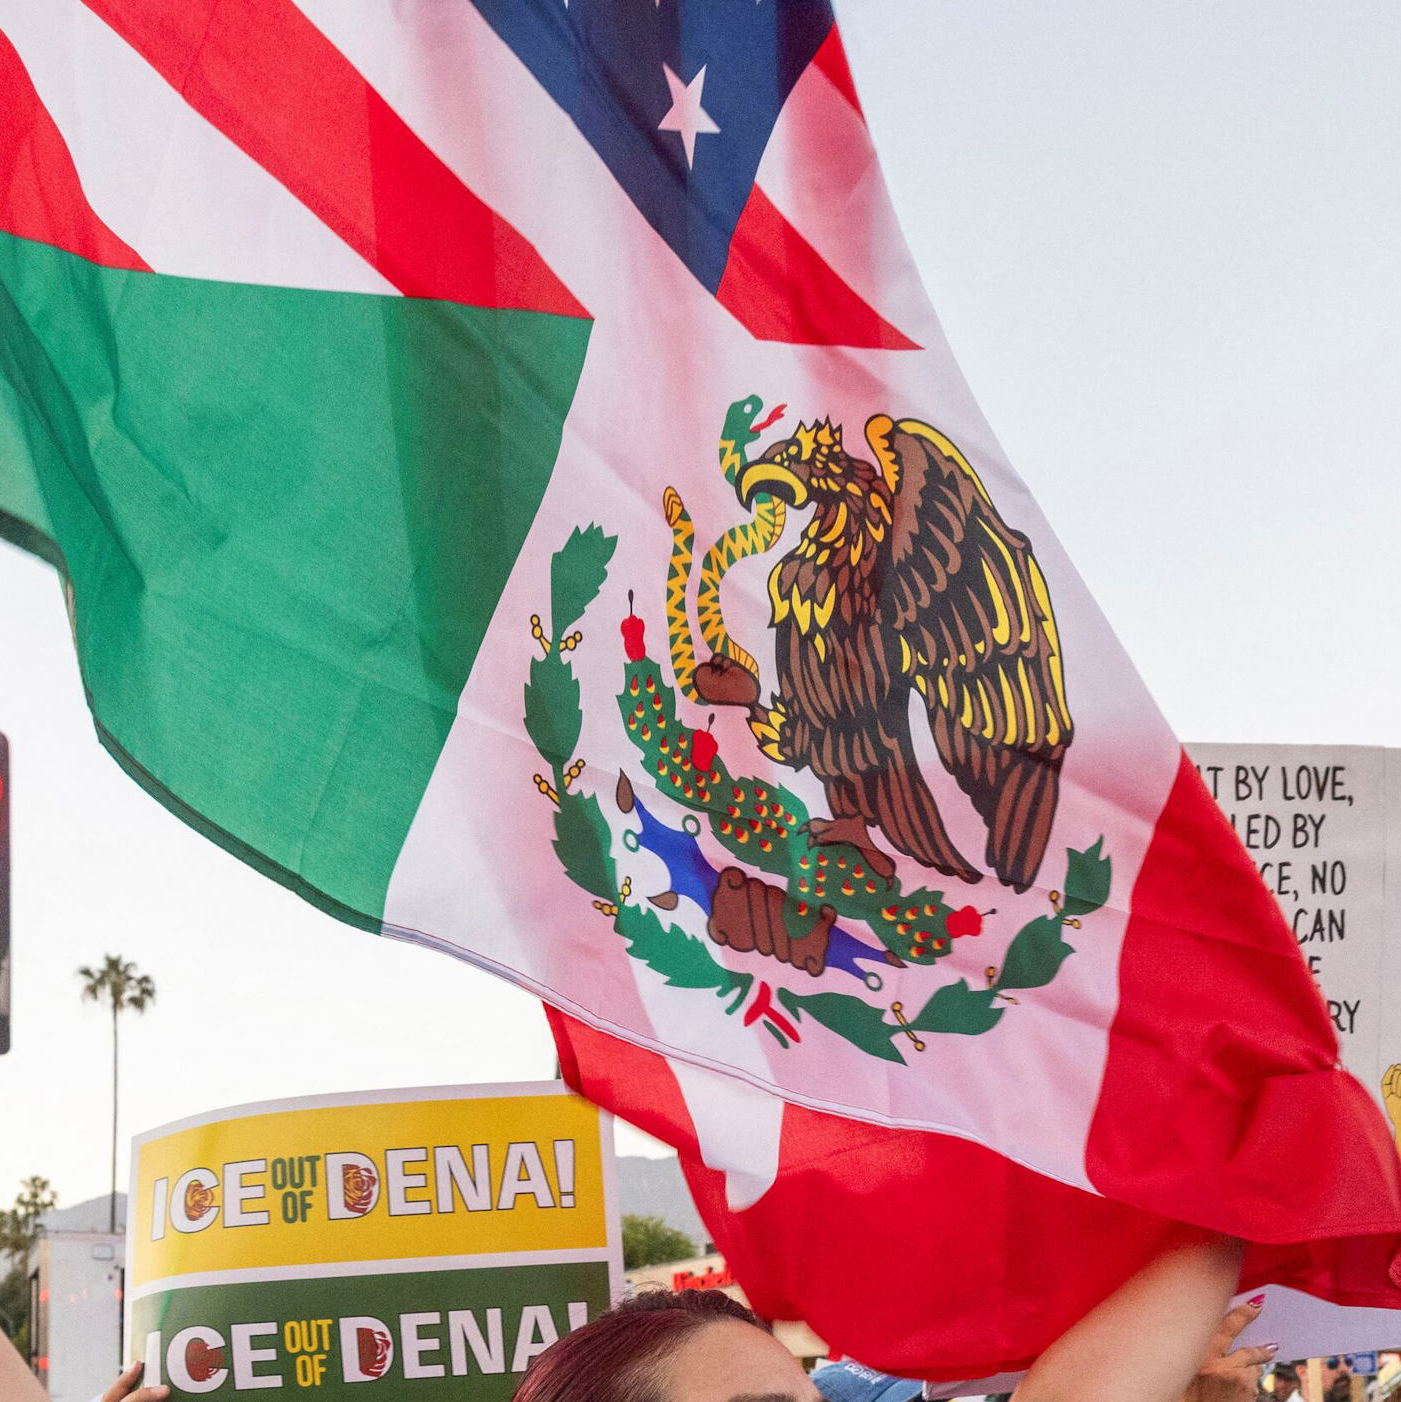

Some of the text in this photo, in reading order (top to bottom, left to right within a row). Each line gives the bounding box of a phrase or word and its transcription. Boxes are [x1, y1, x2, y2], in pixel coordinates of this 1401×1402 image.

[1235, 765, 1269, 801] BY
[1282, 765, 1353, 806] LOVE,
[1292, 813, 1326, 848] BY
[1311, 861, 1347, 895] NO
[150, 1138, 577, 1242] ICE OUT OF DENA!
[284, 1318, 334, 1354] OUT
[143, 1321, 283, 1394] ICE
[295, 1354, 327, 1388] OF
